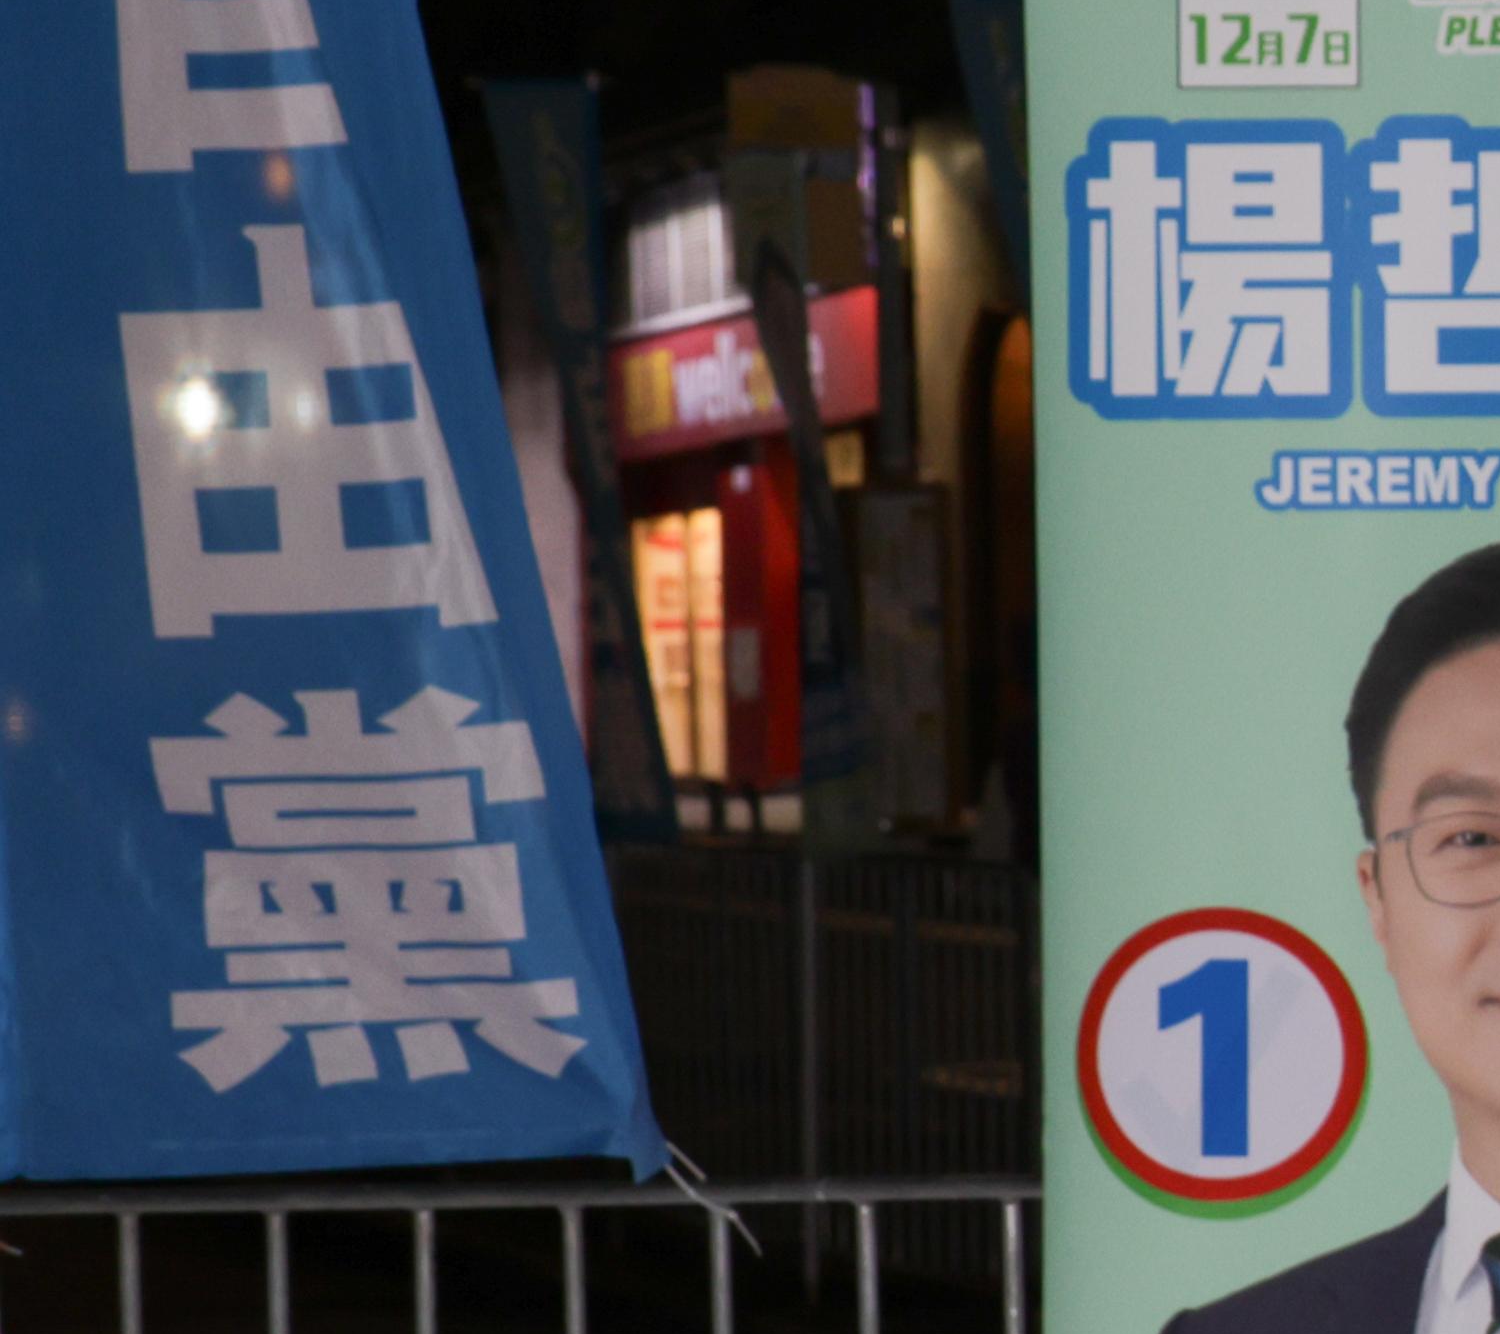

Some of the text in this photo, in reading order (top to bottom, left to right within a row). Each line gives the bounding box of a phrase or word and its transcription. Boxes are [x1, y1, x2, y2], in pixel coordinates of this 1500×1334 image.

[1188, 13, 1350, 66] 12月7日
[1260, 456, 1500, 506] JEREMY
[1158, 959, 1249, 1157] 1
